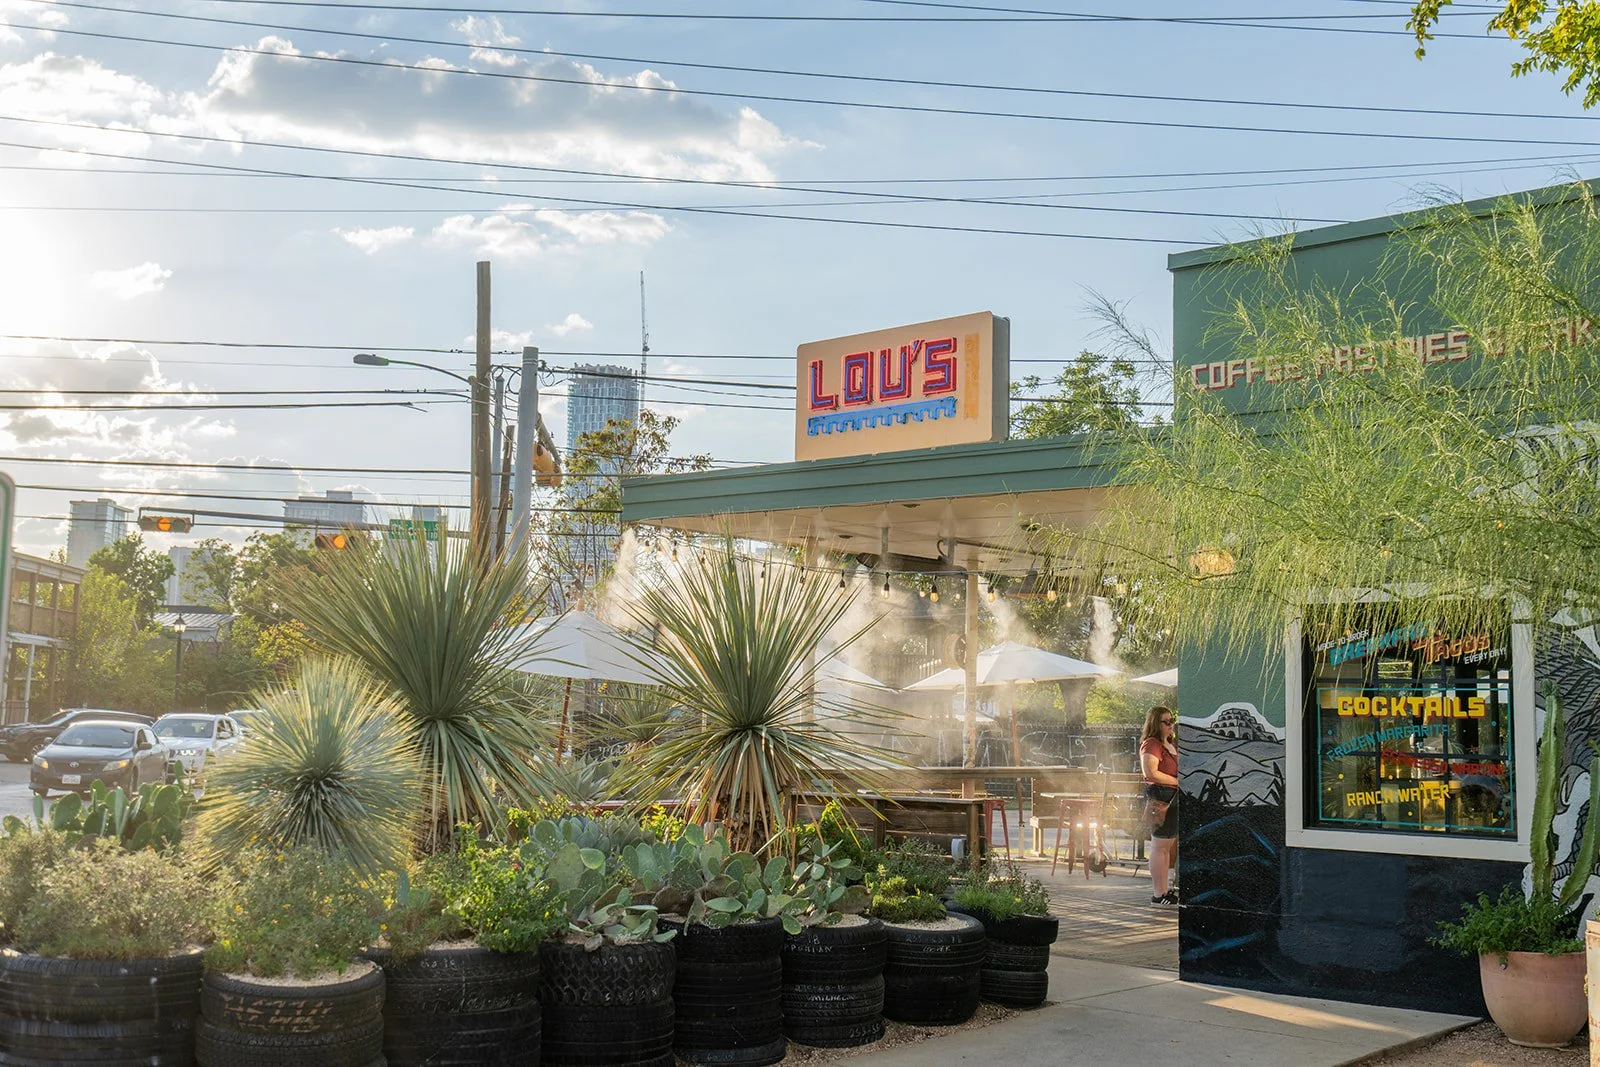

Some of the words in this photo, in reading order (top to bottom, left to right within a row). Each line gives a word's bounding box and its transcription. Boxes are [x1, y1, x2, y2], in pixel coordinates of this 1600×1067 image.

[808, 337, 957, 411] LOU'S
[1191, 355, 1303, 392] COFFEE
[1464, 651, 1488, 665] EVERY
[1337, 696, 1486, 717] COCKTAILS
[1326, 733, 1376, 762] FROZEN
[1346, 788, 1394, 807] RANCH
[1398, 784, 1452, 803] WATER
